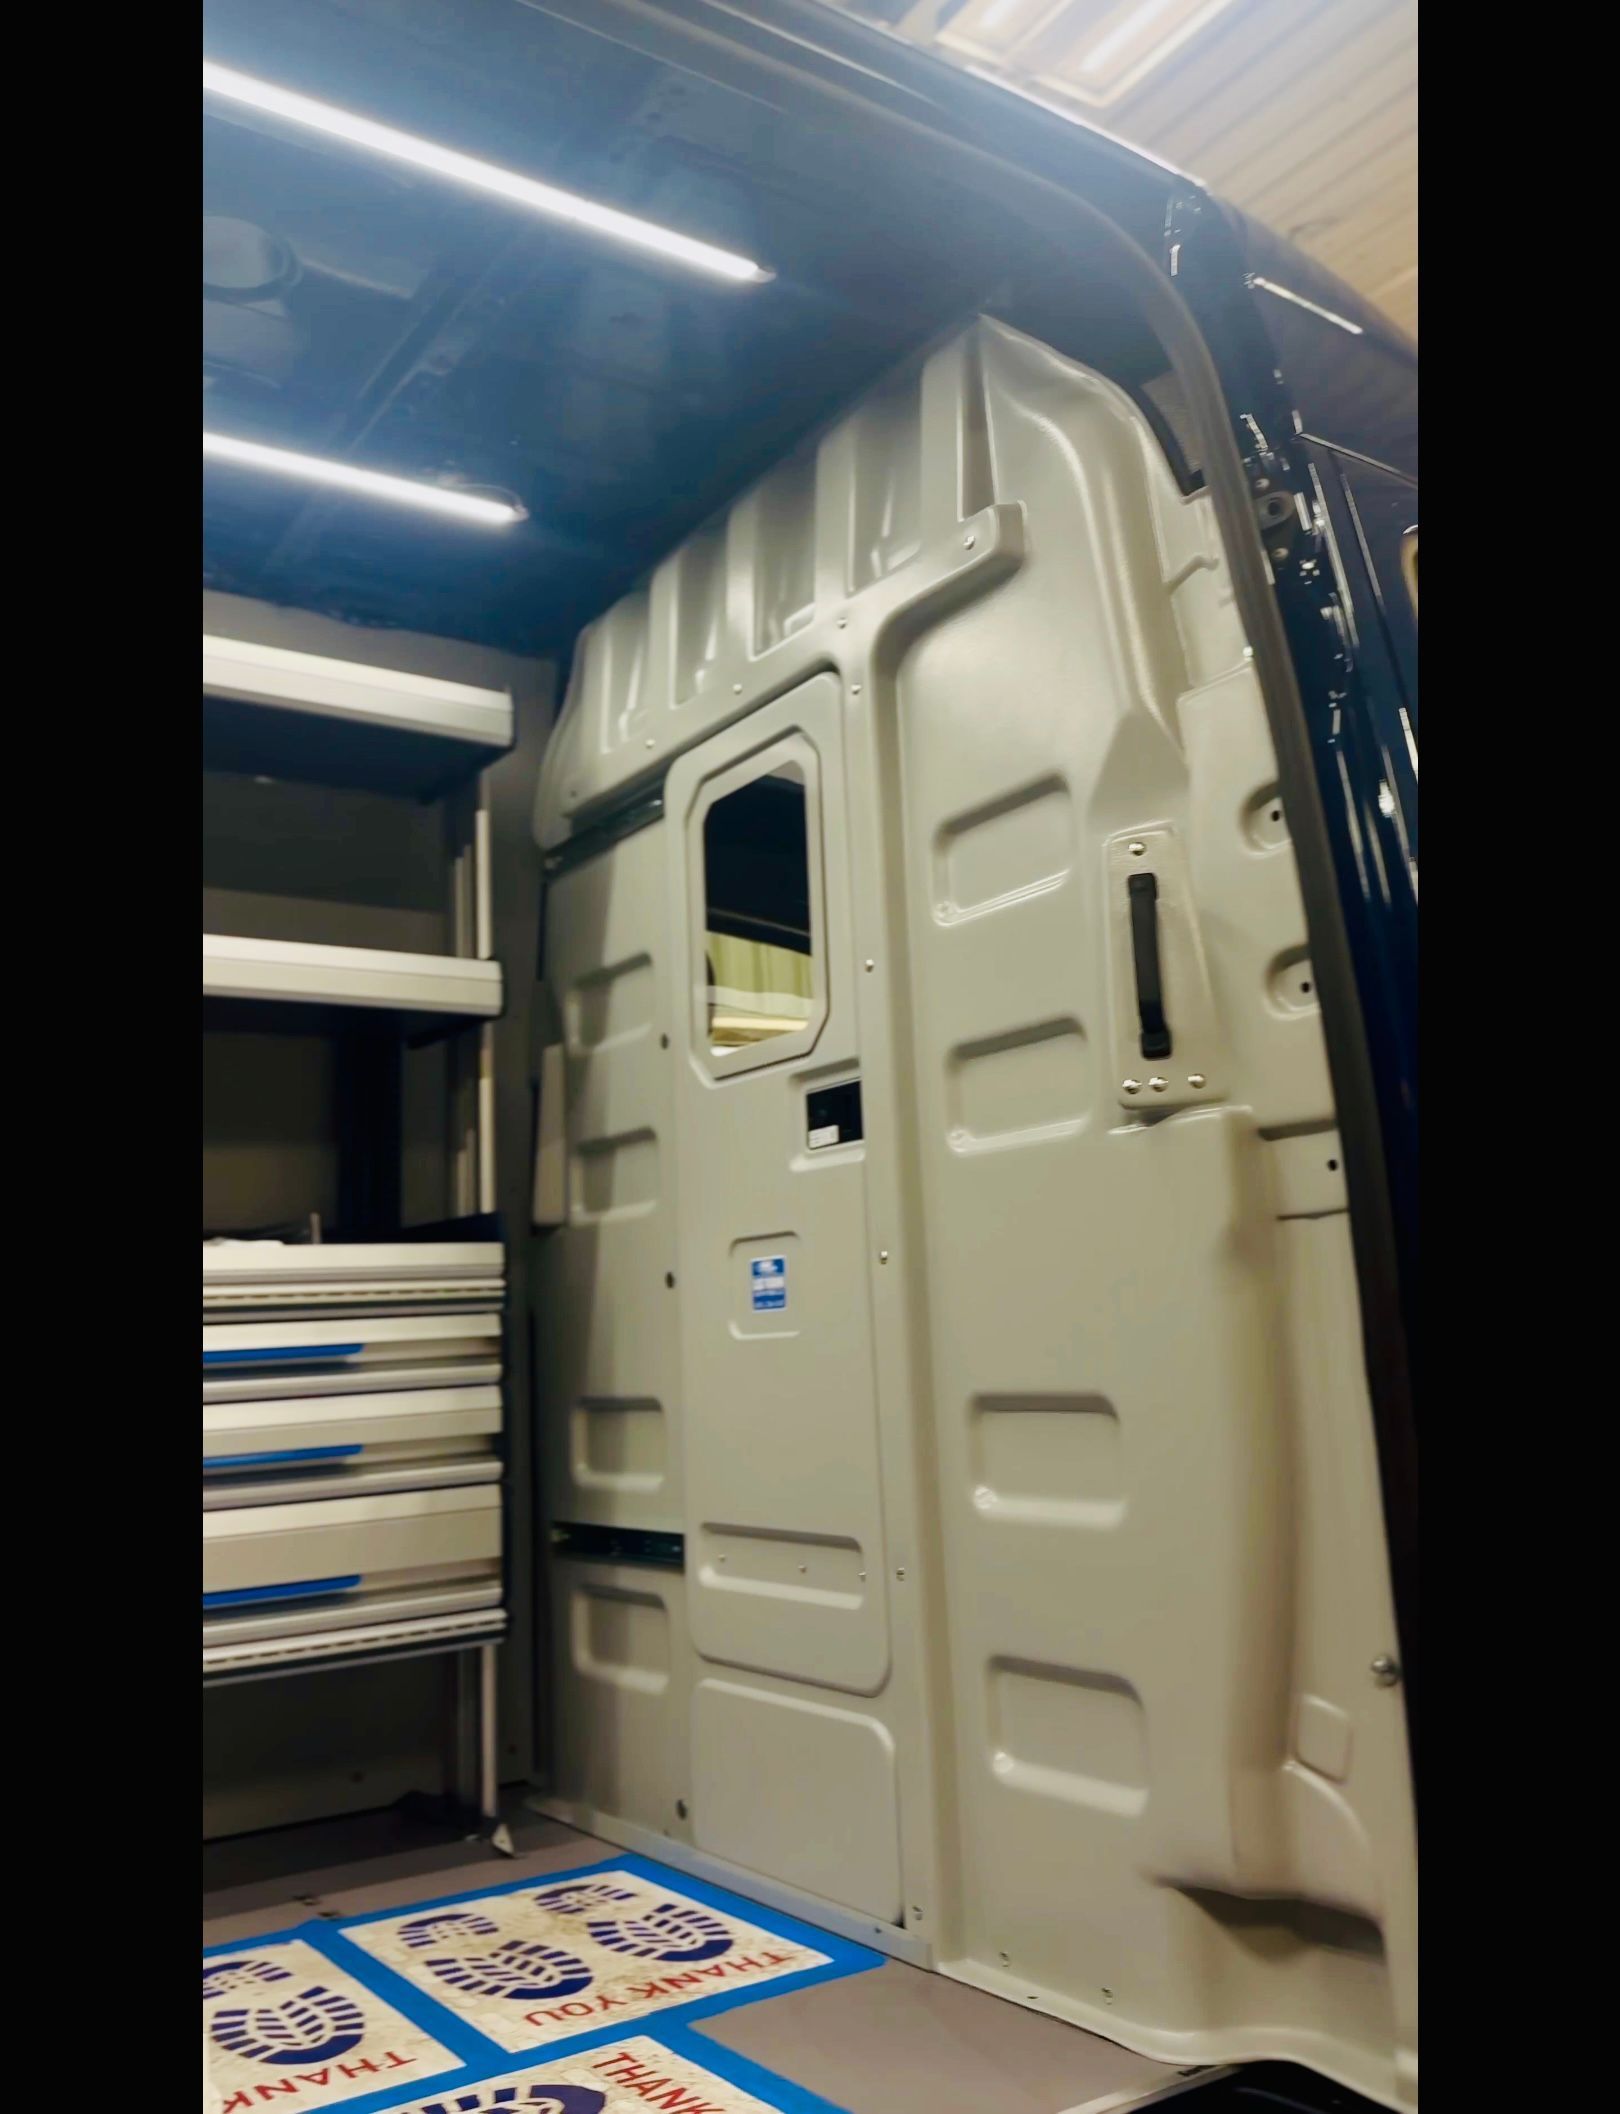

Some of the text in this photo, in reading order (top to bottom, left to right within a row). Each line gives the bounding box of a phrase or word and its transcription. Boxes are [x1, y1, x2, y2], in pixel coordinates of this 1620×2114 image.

[523, 1951, 795, 2027] THANK YOU
[221, 2050, 417, 2114] THANK
[592, 2051, 726, 2114] THANK
